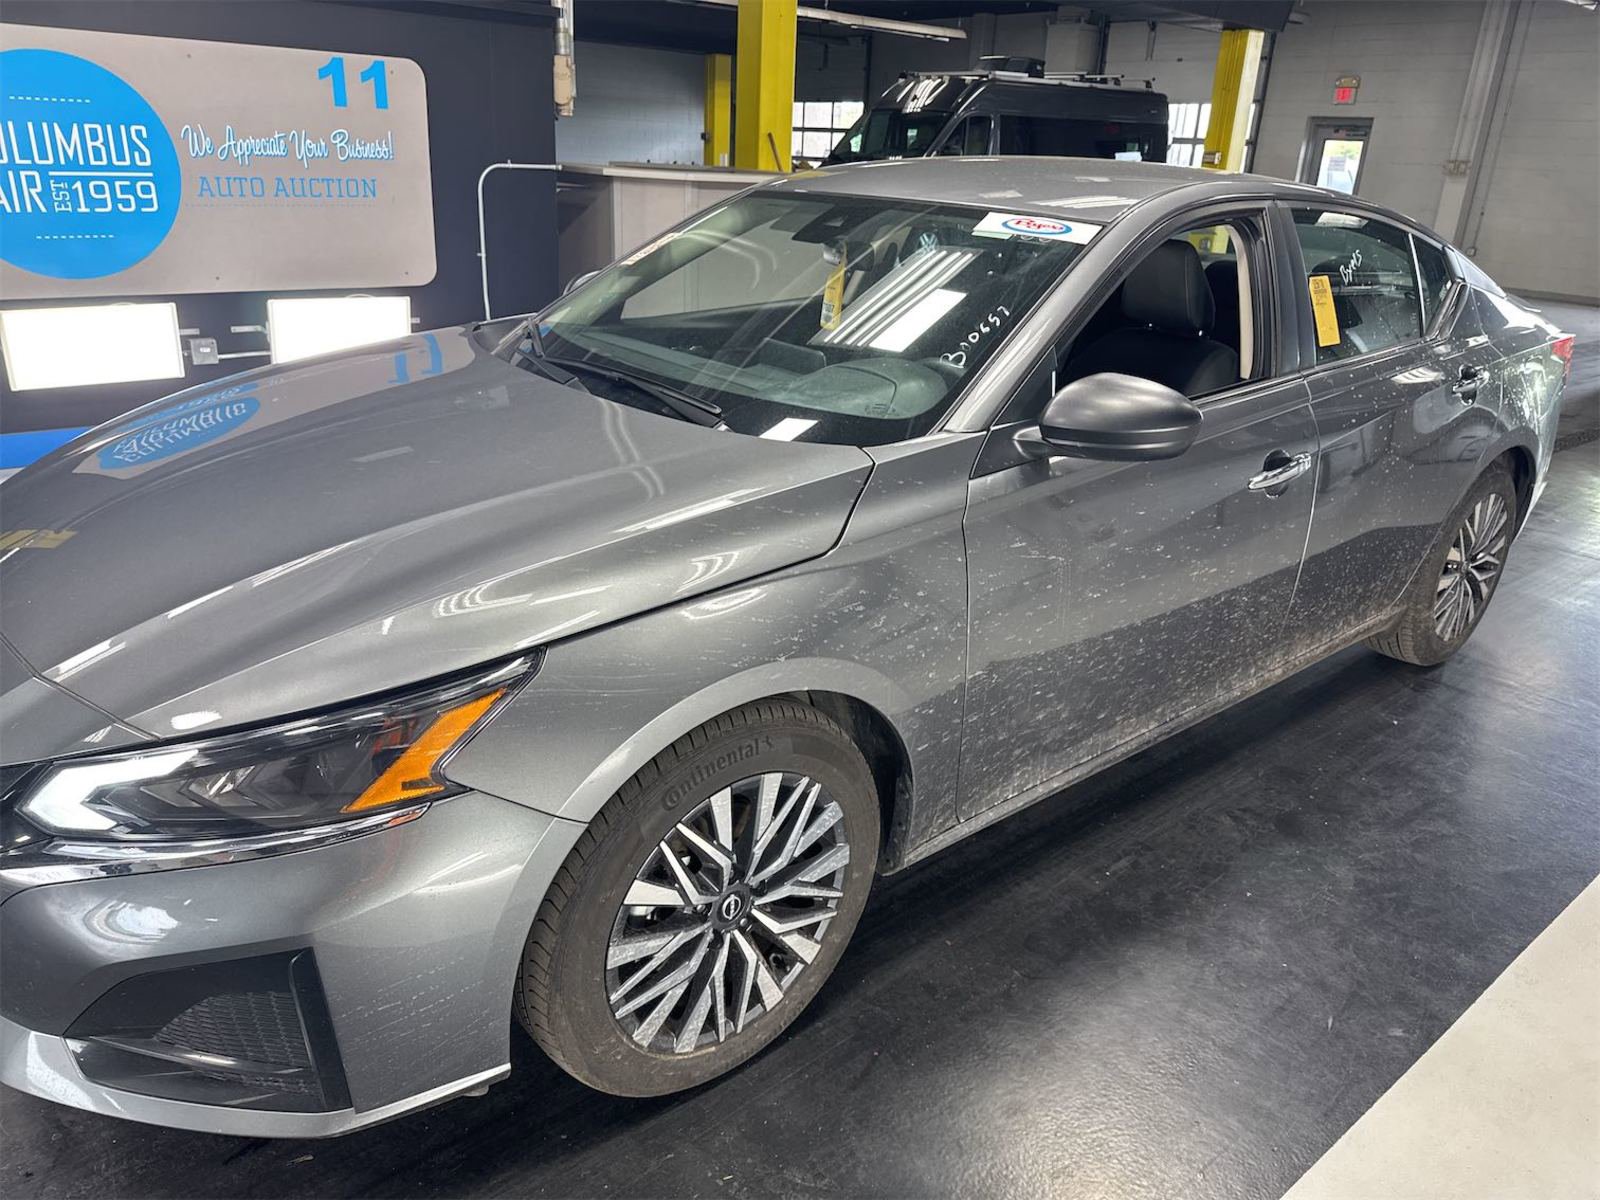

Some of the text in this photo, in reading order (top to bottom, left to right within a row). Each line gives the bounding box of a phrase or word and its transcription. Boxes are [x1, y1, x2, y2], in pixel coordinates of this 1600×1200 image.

[318, 56, 389, 110] 11
[181, 123, 394, 169] We Appreciate Your Business!
[50, 179, 73, 213] EST
[71, 180, 159, 213] 1959
[197, 176, 377, 199] AUTO AUCTION
[661, 737, 761, 812] Continental
